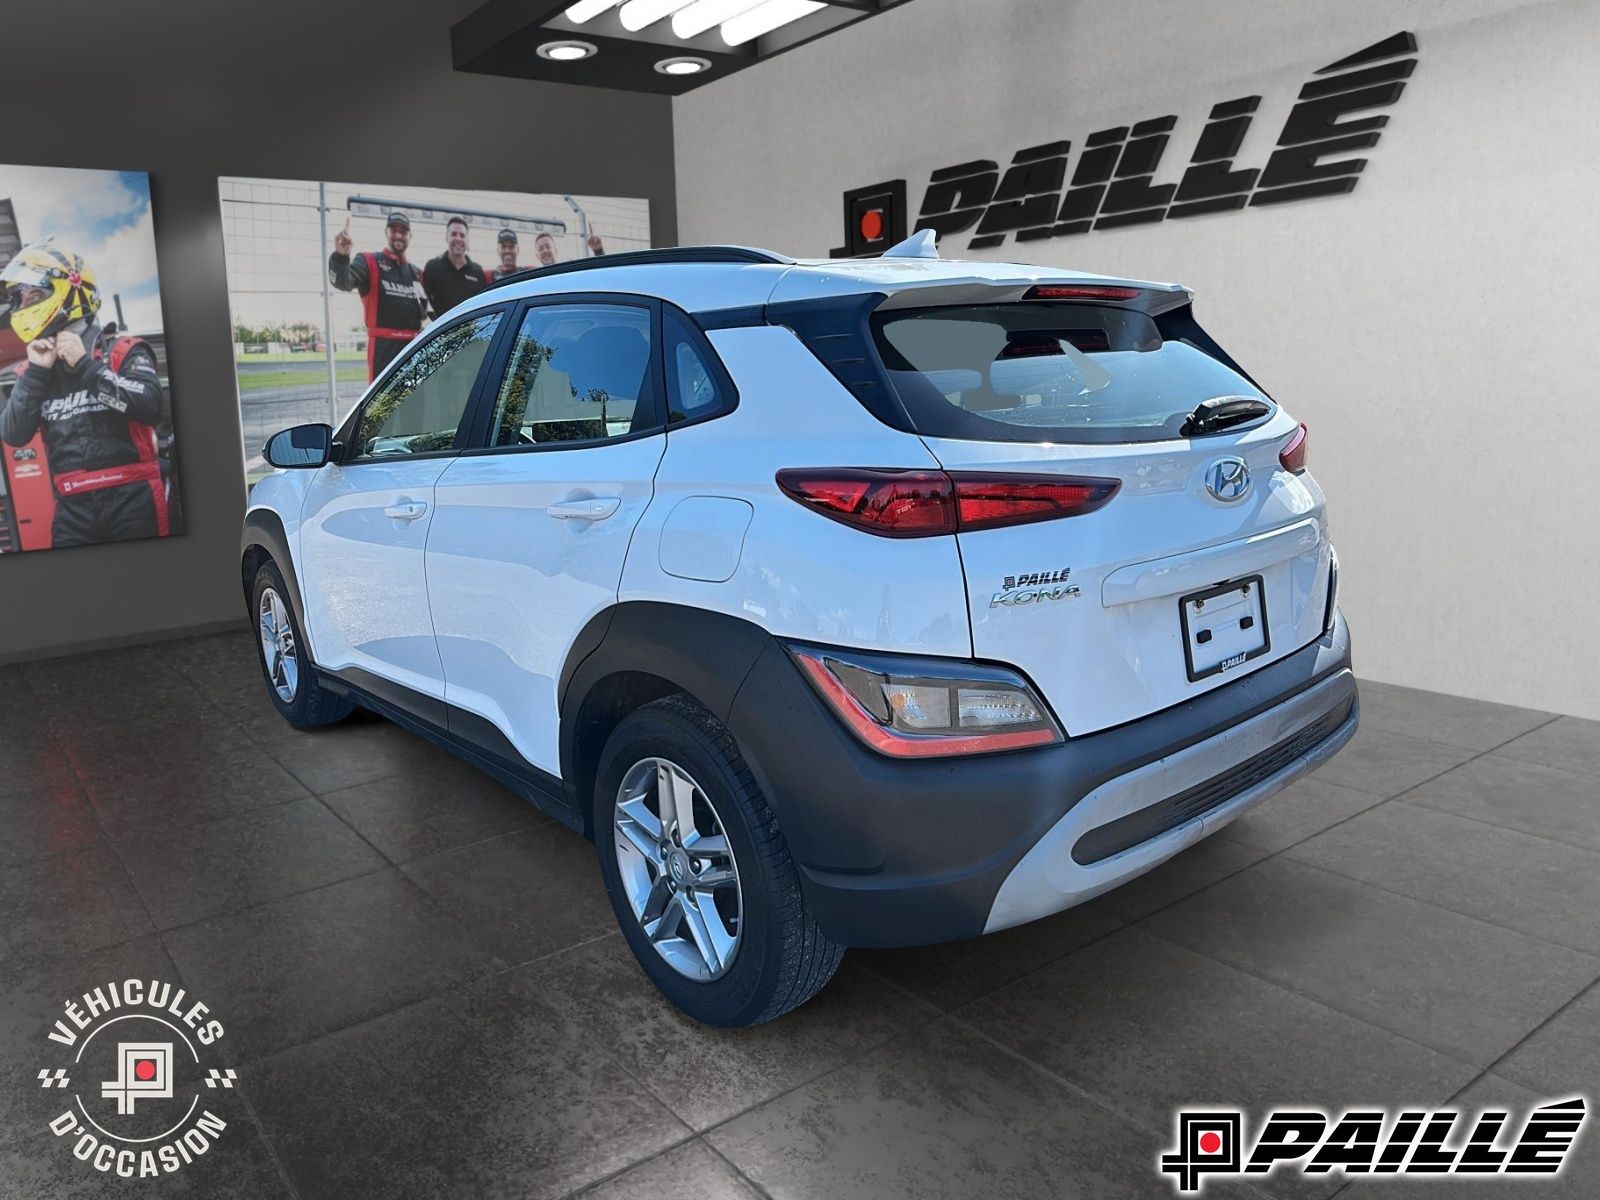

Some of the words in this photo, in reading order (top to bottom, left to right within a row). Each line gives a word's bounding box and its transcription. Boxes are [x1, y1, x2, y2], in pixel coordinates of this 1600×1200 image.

[911, 31, 1418, 250] PAILLÉ
[1017, 567, 1070, 587] PAILLÉ
[989, 584, 1080, 608] KONA
